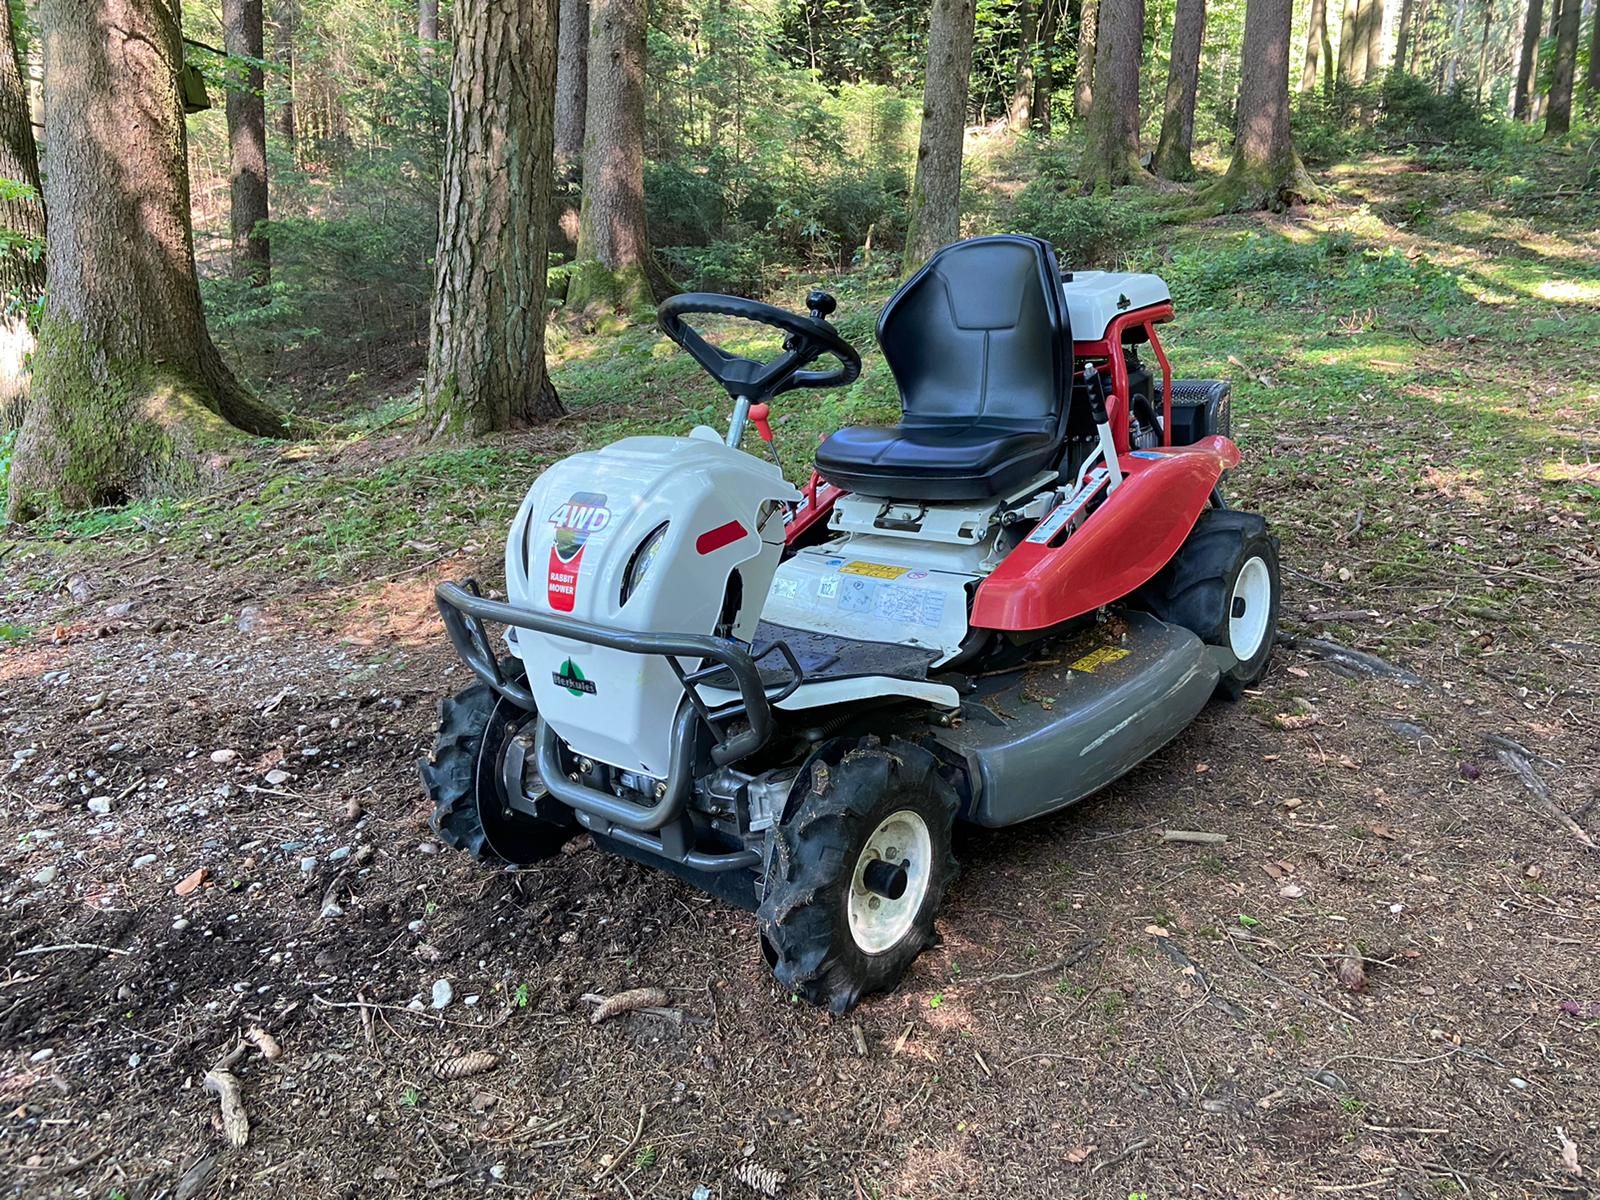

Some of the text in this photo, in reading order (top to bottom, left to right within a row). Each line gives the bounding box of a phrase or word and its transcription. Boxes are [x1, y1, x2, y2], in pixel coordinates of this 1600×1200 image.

[549, 503, 611, 533] 4WD
[550, 572, 574, 584] RABBIT
[549, 583, 574, 595] MOWER
[553, 672, 595, 693] Herkules
